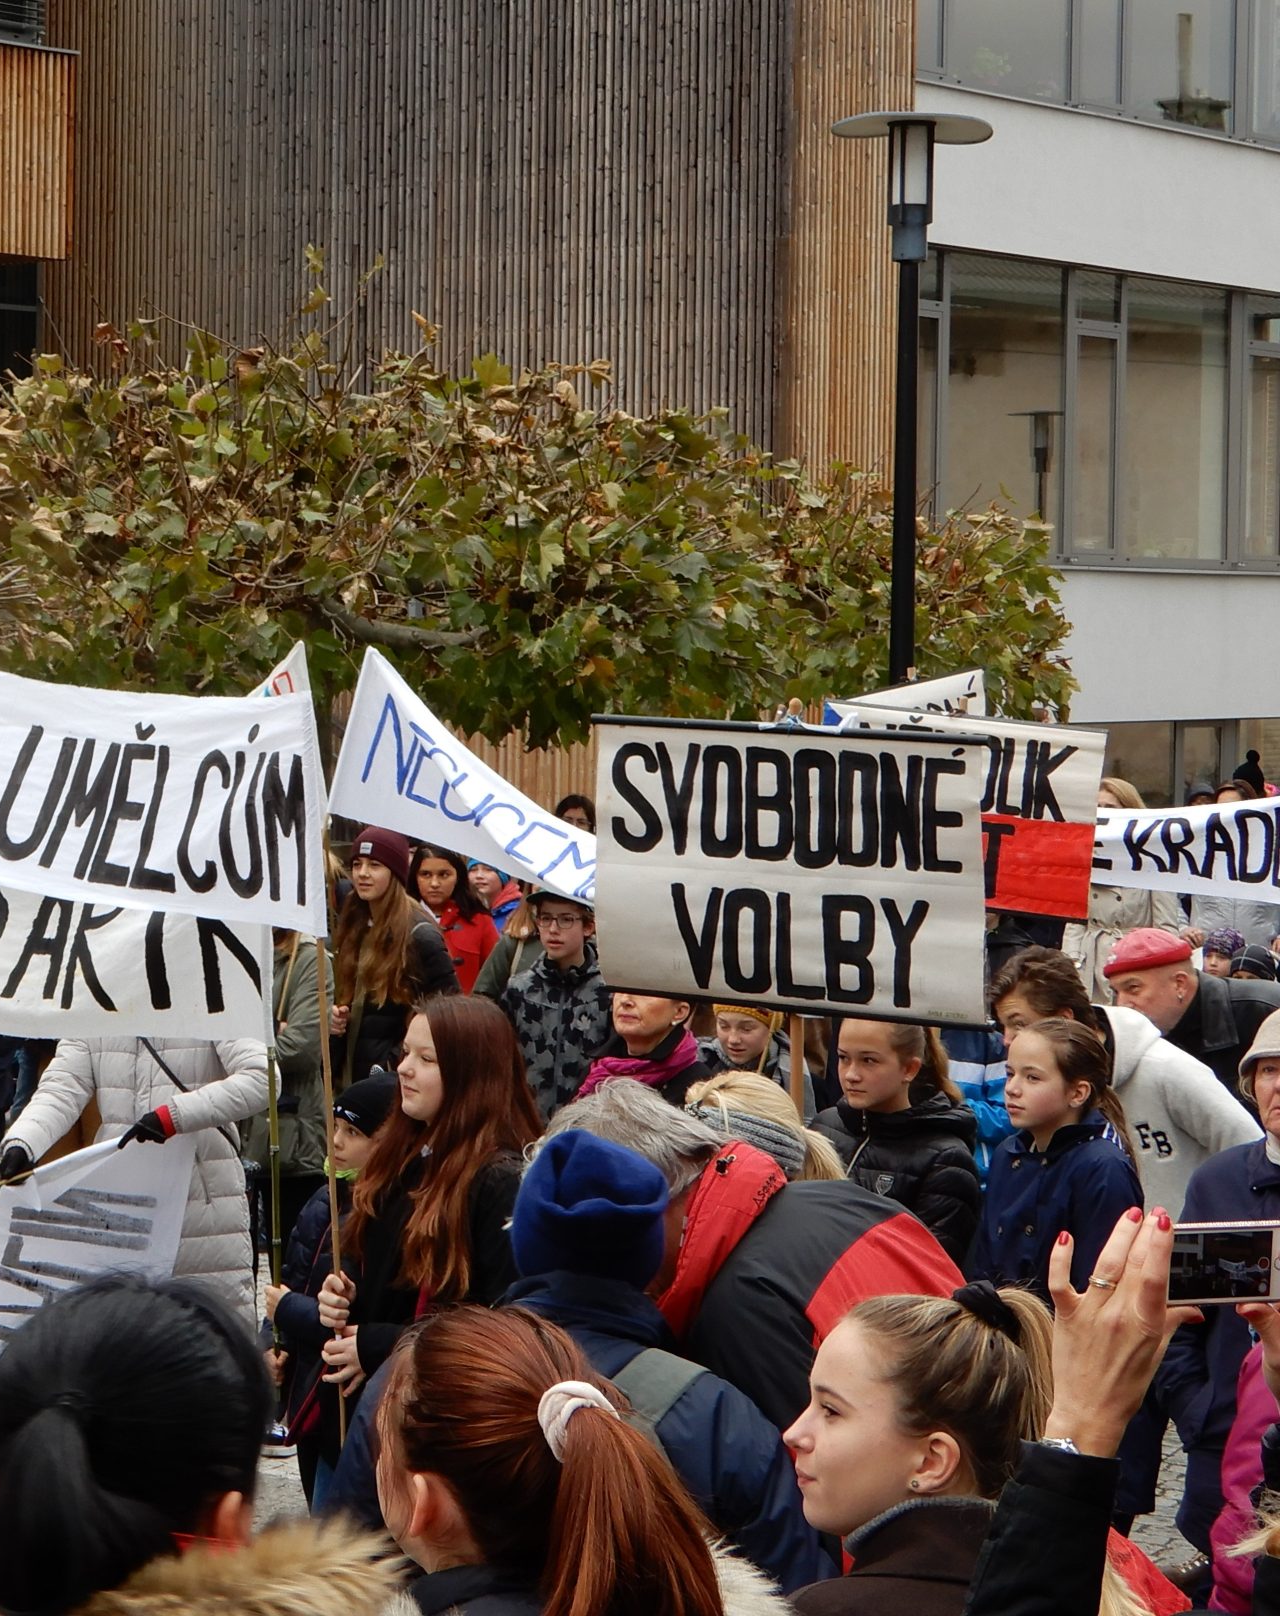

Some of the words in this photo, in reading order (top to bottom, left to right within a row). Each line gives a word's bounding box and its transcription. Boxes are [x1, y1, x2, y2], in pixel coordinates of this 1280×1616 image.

[611, 742, 966, 874] SVOBODNÉ
[1123, 808, 1280, 888] KRAD
[671, 883, 930, 1008] VOLBY
